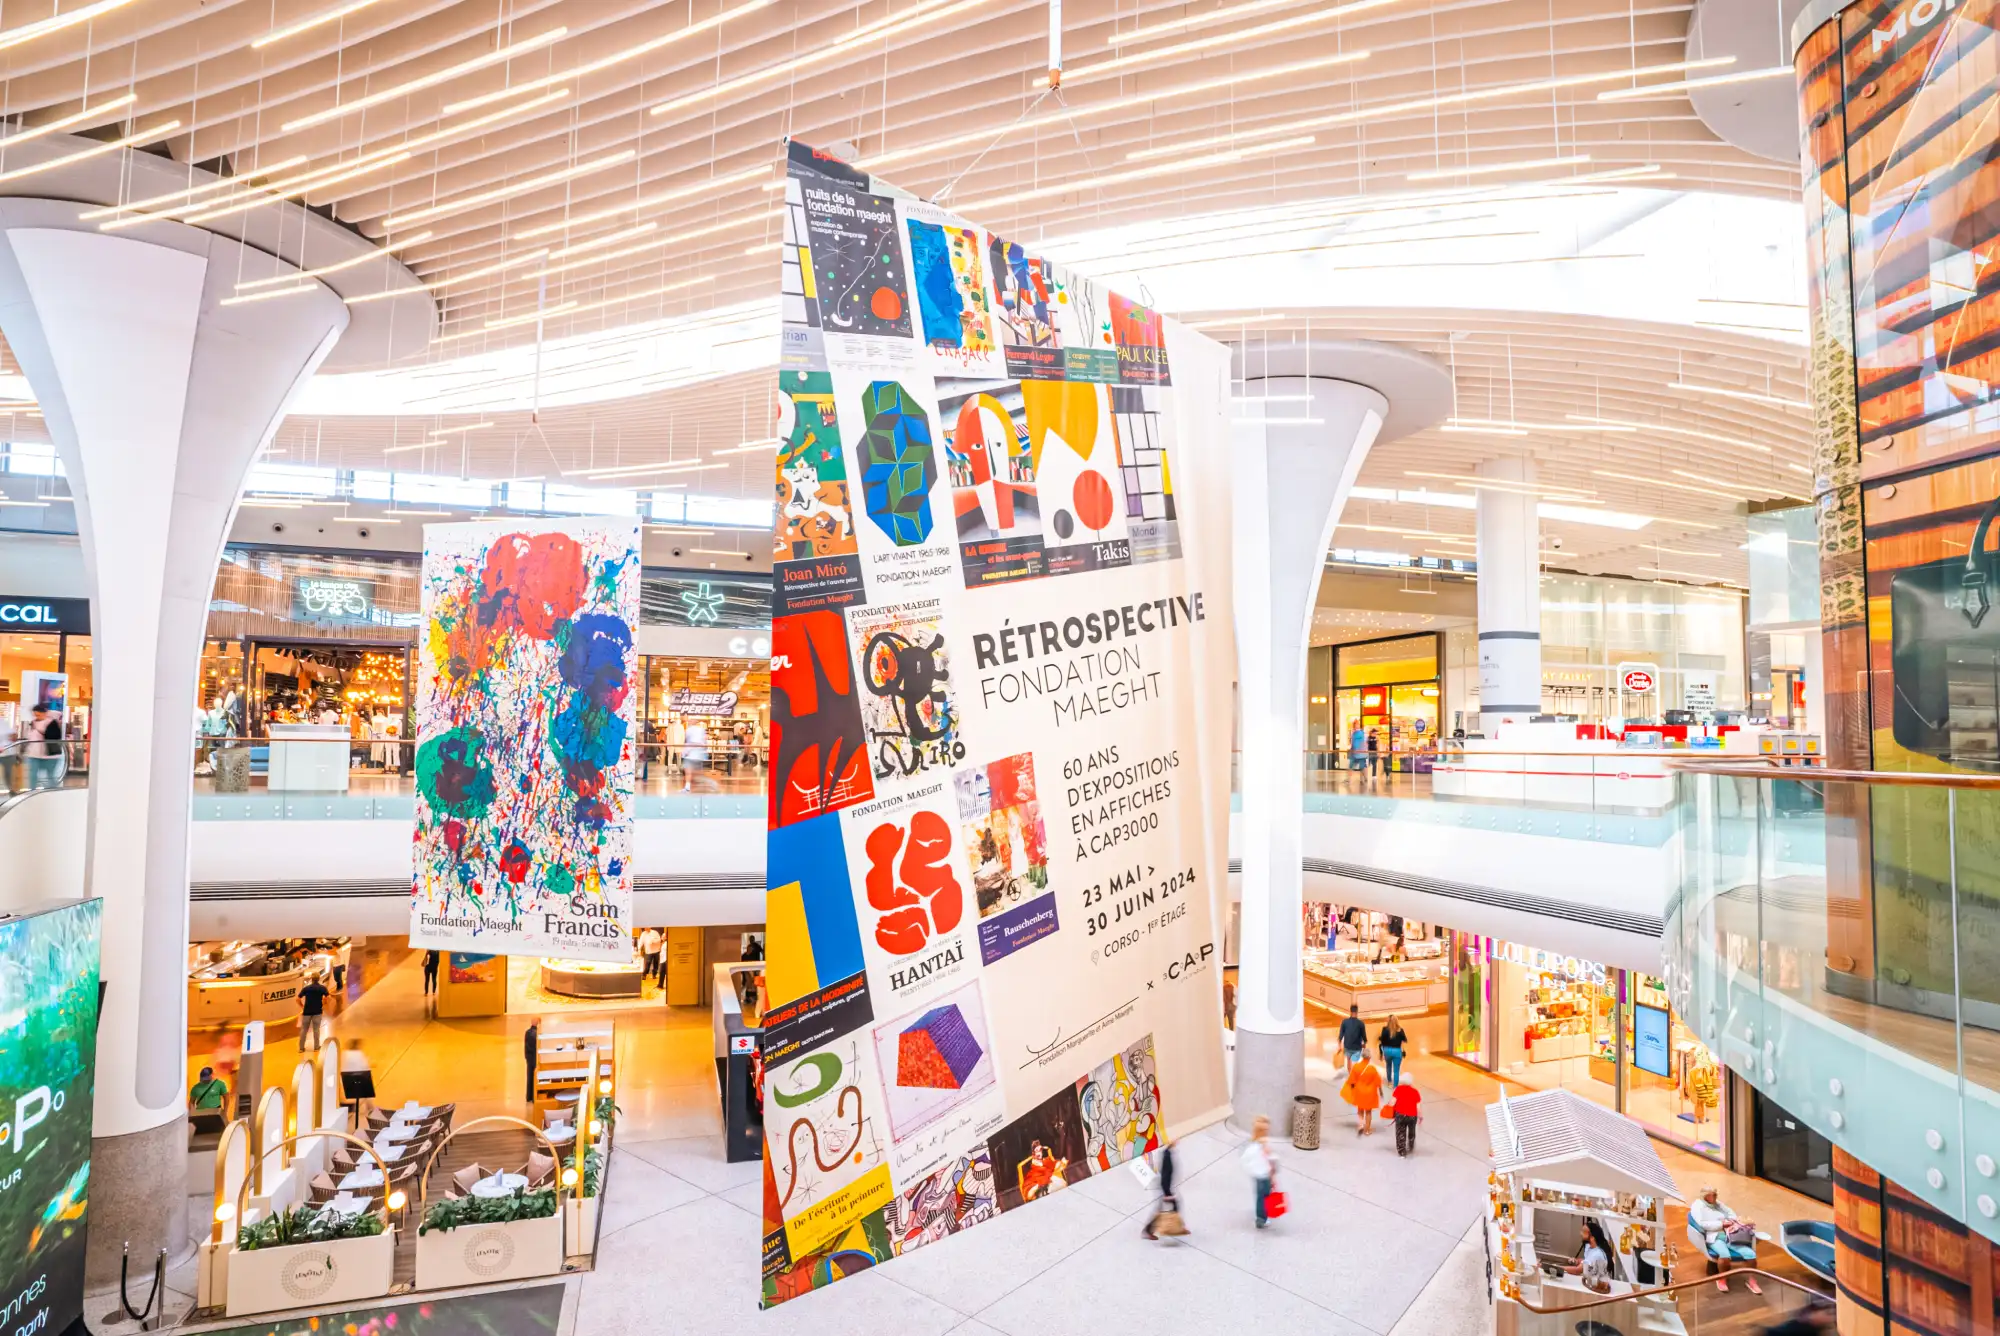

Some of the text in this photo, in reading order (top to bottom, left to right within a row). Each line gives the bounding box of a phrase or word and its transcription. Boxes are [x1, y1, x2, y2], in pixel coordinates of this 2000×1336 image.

[805, 188, 855, 206] nuits de la
[807, 199, 893, 223] fondation maeght
[1116, 346, 1168, 365] PAUL KLEE
[873, 553, 890, 564] L'ART
[892, 550, 917, 561] VIVANT
[1092, 541, 1130, 562] Takis
[783, 562, 848, 583] Joan Miró
[784, 581, 819, 592] Rétrospective
[876, 566, 952, 583] FONDATION MAEGHT
[786, 593, 854, 609] Fondation Maeght
[851, 604, 901, 618] FONDATION
[903, 598, 940, 610] MAEGHT
[973, 592, 1205, 669] RÉTROSPECTIVE
[981, 644, 1140, 709] FONDATION
[1053, 672, 1160, 727] MAEGHT
[1063, 745, 1119, 780] 60 ANS
[1067, 751, 1180, 807] D'EXPOSITIONS
[851, 795, 903, 818] FONDATION
[907, 783, 943, 801] MAEGHT
[1072, 780, 1171, 834] EN AFFICHES
[1076, 812, 1158, 862] À CAP3000
[1083, 884, 1102, 908] 23
[1110, 865, 1141, 895] MAI
[570, 895, 619, 918] Sam
[1087, 867, 1196, 936] 30 JUIN 2024
[420, 913, 523, 932] Fondation Maeght
[544, 914, 619, 938] Francis
[1003, 909, 1054, 937] Rauschenberg
[1104, 929, 1140, 957] CORSO
[1160, 902, 1186, 928] ÉTAGE
[1012, 931, 1037, 947] Fondation
[889, 940, 965, 991] HANTAÏ
[1491, 938, 1605, 986] LOLLIPOPS
[762, 1006, 797, 1028] ATELIERS
[798, 1002, 809, 1013] DE
[810, 997, 820, 1008] LA
[774, 1041, 800, 1058] MAEGHT
[1038, 1047, 1067, 1068] Fondation
[1067, 1030, 1096, 1051] Marguerite
[1115, 1005, 1134, 1020] Maeght
[921, 1160, 938, 1173] novembre
[793, 1192, 851, 1230] De l'écriture
[830, 1181, 886, 1220] à la peinture
[816, 1224, 844, 1244] Fondation
